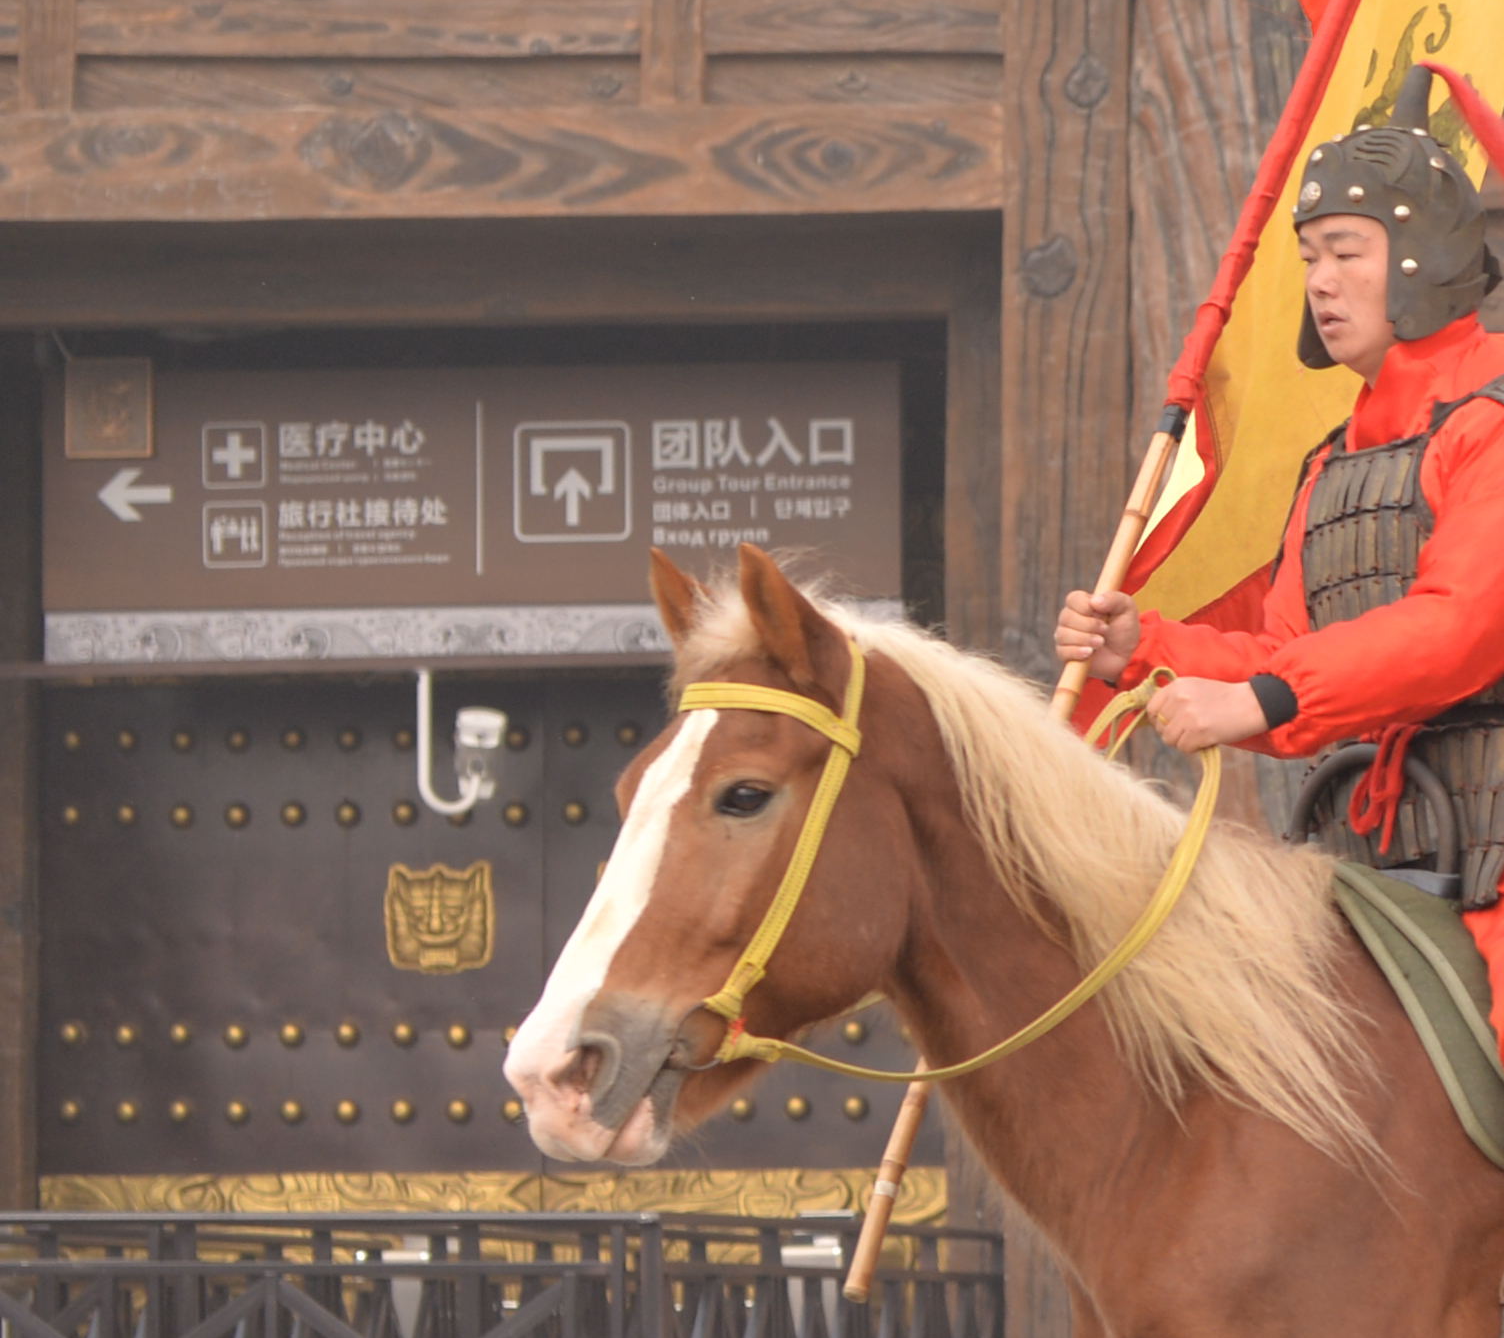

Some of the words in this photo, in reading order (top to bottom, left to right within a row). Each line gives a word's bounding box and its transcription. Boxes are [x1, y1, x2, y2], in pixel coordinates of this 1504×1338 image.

[279, 419, 426, 458] 医疗中心
[652, 417, 854, 469] 团队入口
[652, 475, 712, 495] Group
[716, 473, 761, 492] Tour
[764, 472, 851, 492] Entrance
[279, 496, 448, 529] 旅行社接待处
[653, 526, 706, 547] Вход
[708, 527, 770, 547] групп
